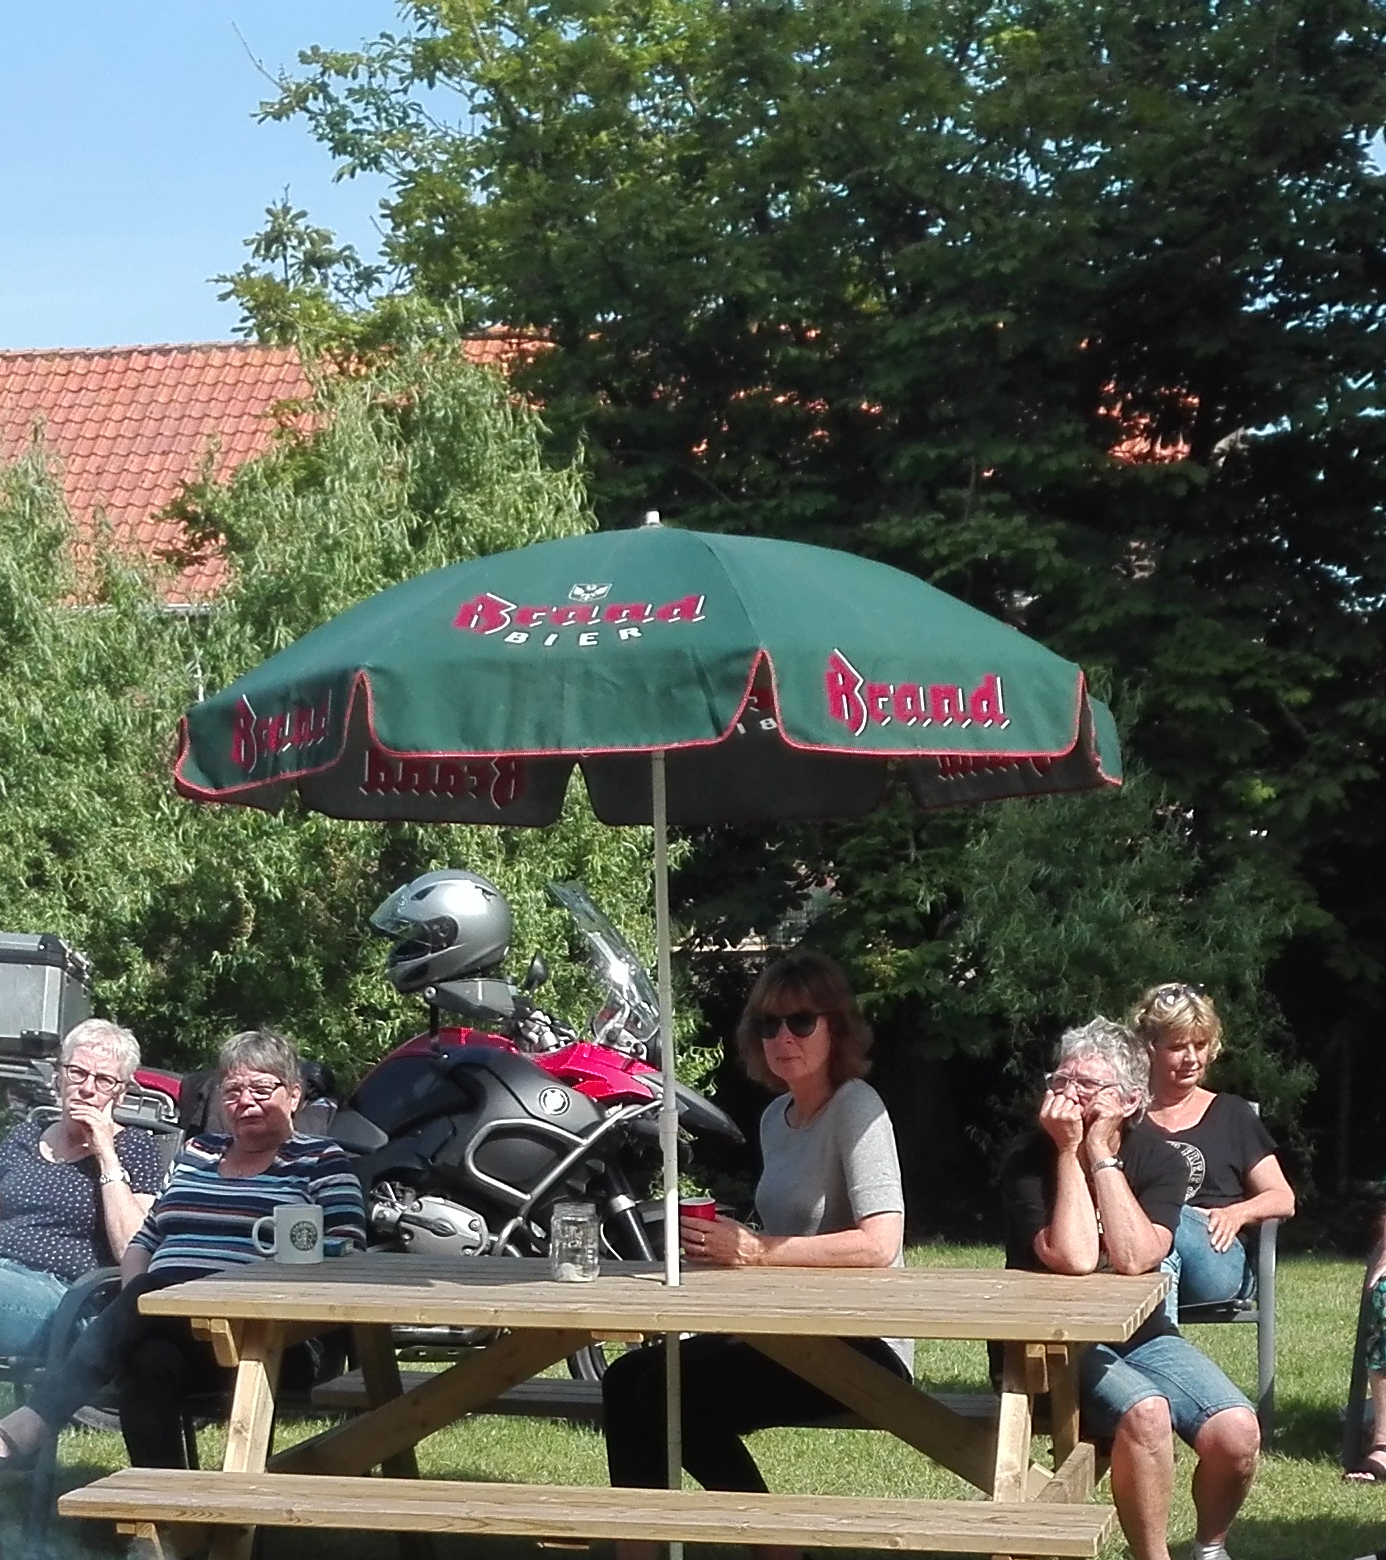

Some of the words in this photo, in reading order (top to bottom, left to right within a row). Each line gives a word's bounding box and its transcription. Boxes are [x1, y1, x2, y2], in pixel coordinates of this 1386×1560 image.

[451, 591, 706, 635] Brand
[503, 626, 643, 647] BIER
[824, 647, 1011, 737] Brand
[1180, 1144, 1204, 1185] FREE
